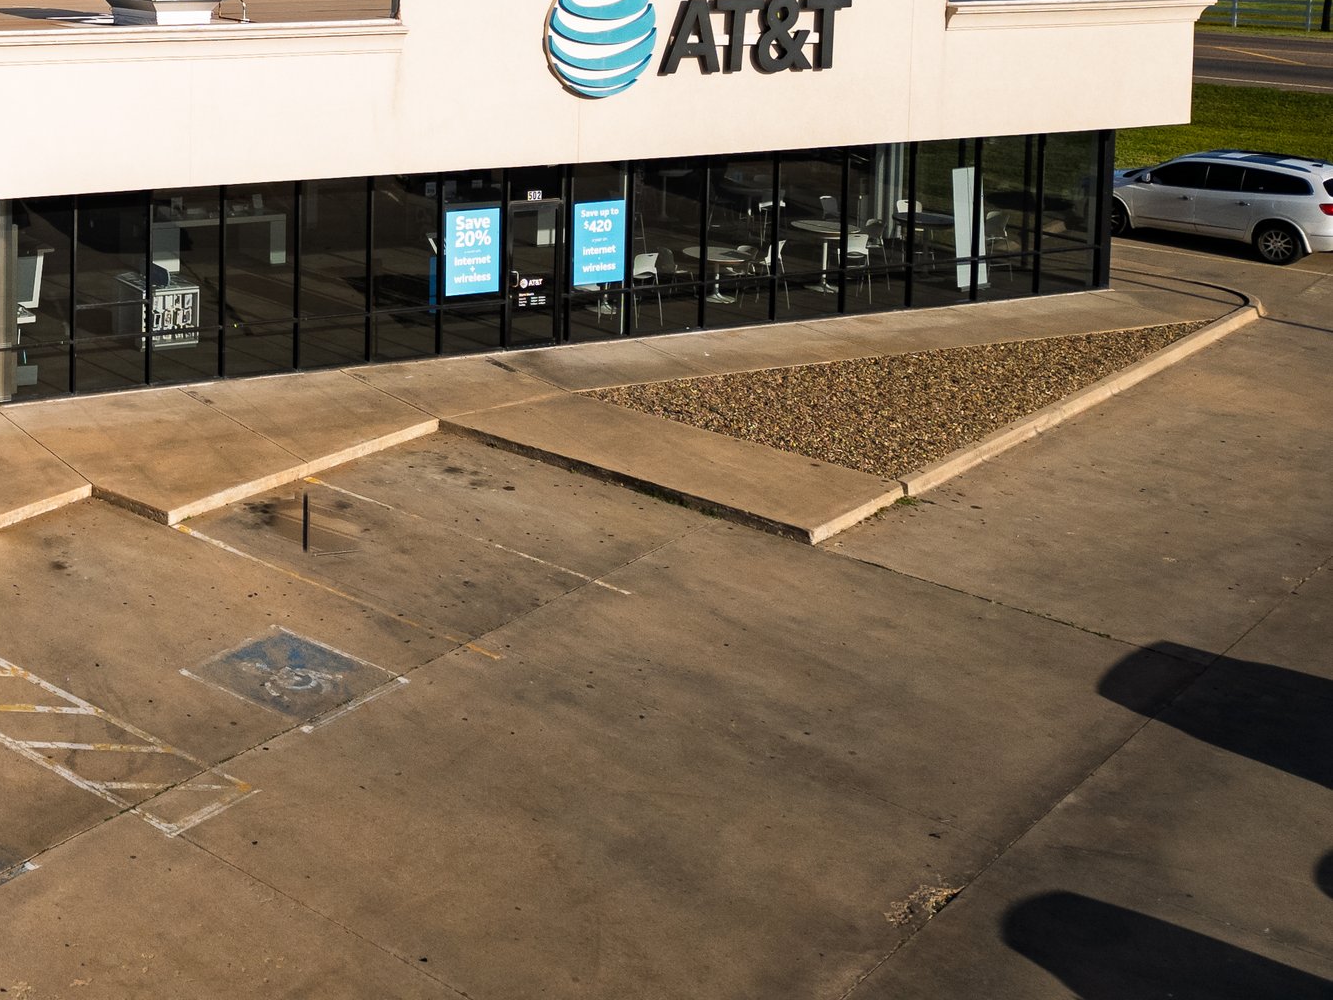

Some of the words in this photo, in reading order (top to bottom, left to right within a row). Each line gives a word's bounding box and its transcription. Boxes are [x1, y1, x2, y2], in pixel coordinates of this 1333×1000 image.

[528, 190, 542, 200] 502
[581, 209, 598, 218] Save
[600, 209, 609, 218] up
[455, 215, 491, 231] Save
[584, 218, 612, 233] $420
[455, 230, 492, 248] 20%
[582, 261, 616, 273] wireless
[454, 272, 492, 284] wireless
[528, 278, 543, 287] AT&T
